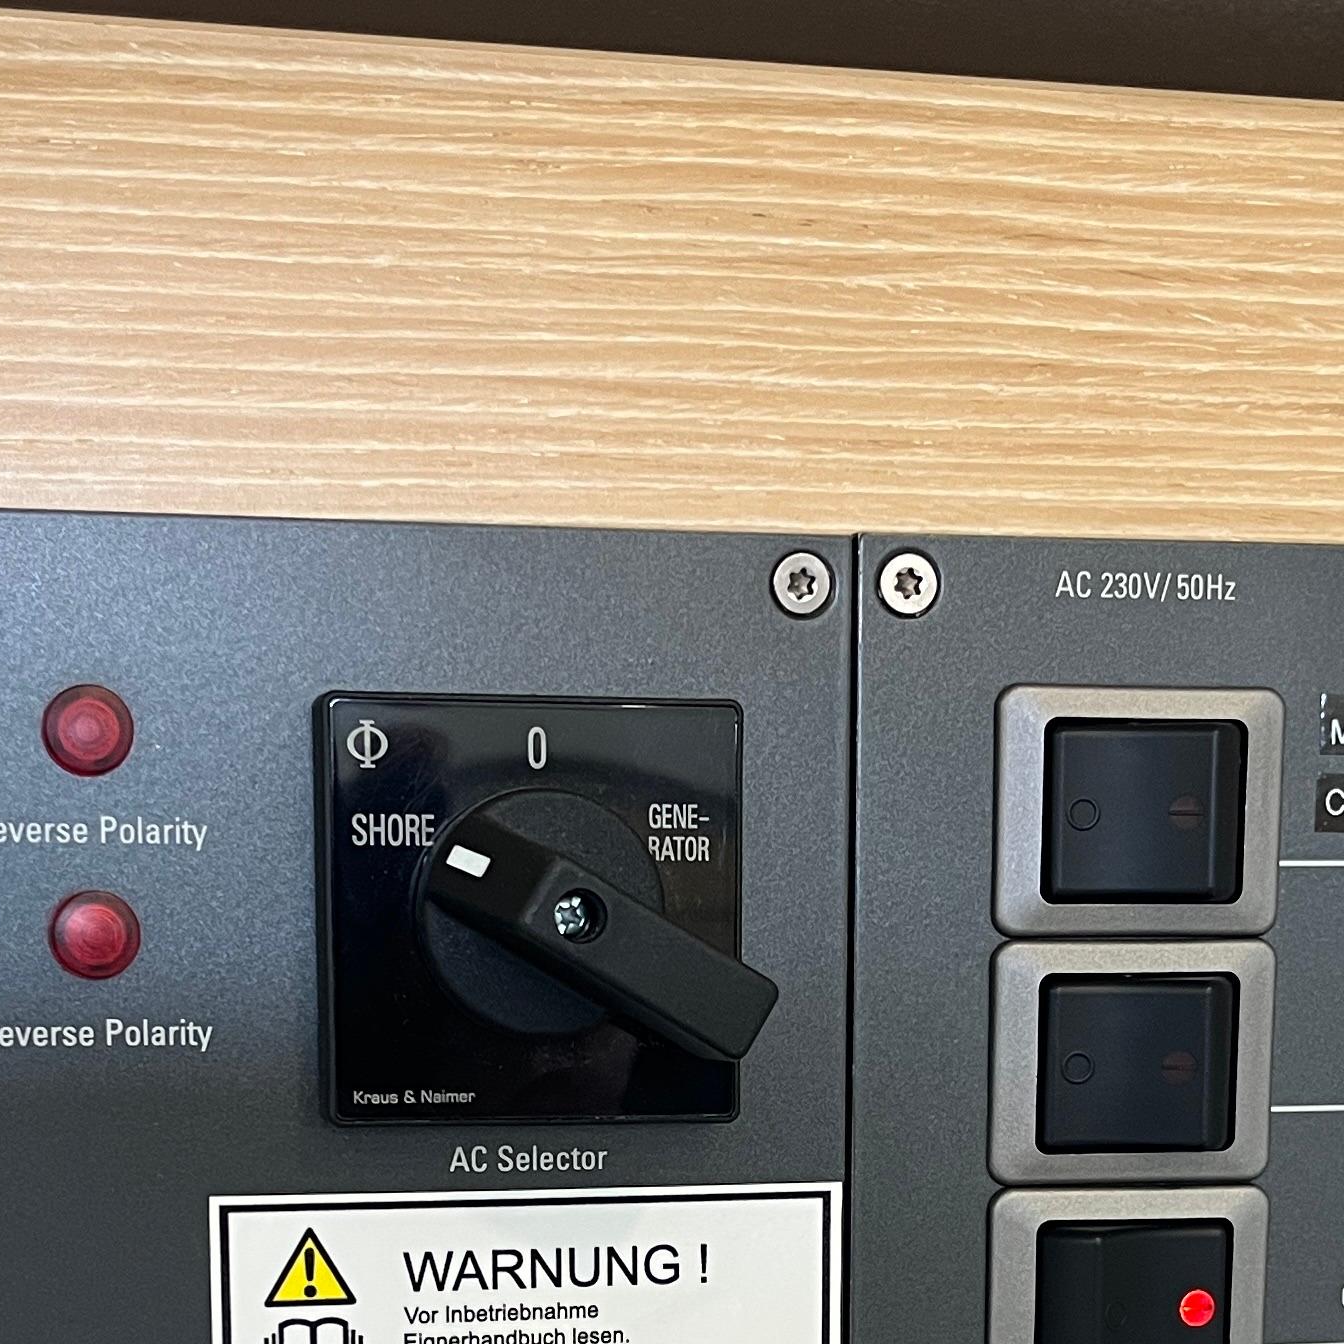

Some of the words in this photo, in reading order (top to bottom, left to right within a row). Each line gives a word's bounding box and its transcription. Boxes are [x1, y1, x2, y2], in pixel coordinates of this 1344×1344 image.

[1055, 570, 1092, 598] AC
[1177, 573, 1236, 601] 50Hz
[527, 726, 547, 770] 0
[351, 813, 435, 847] SHORE
[648, 803, 710, 829] GENE-
[100, 815, 208, 852] Polarity
[648, 835, 710, 862] RATOR
[105, 1018, 213, 1052] Polarity
[353, 1090, 399, 1105] Kraus
[403, 1089, 417, 1104] &
[420, 1089, 476, 1104] Naimer
[449, 1145, 488, 1173] AC
[497, 1145, 608, 1172] Selector
[402, 1244, 680, 1293] WARNUNG
[700, 1243, 708, 1284] !
[403, 1306, 439, 1325] Vor
[445, 1301, 599, 1324] Inbetriebnahme
[572, 1327, 630, 1344] lesen.
